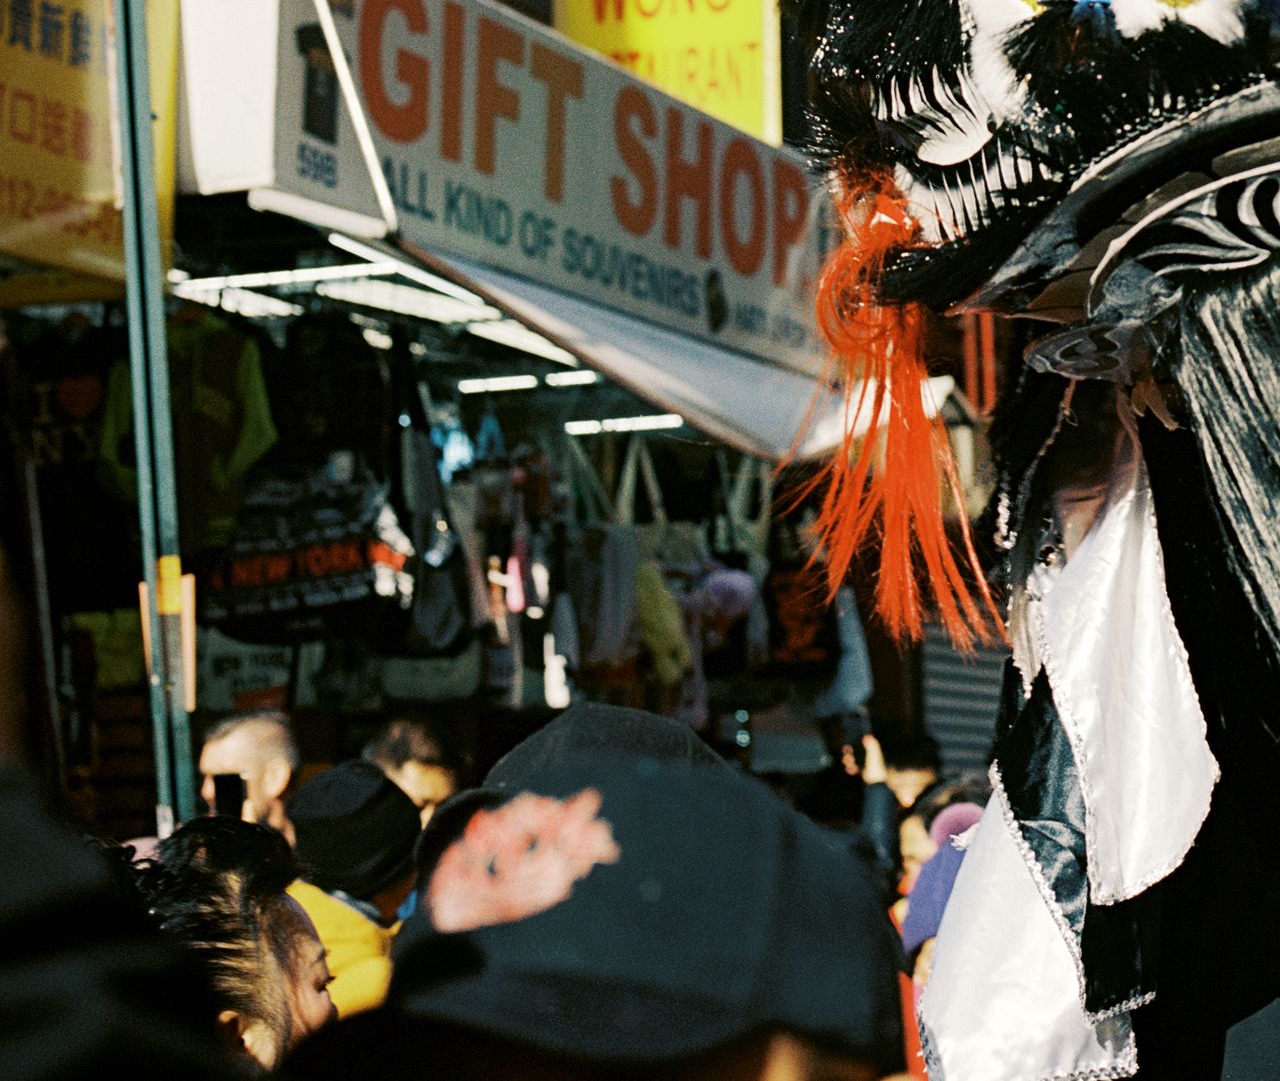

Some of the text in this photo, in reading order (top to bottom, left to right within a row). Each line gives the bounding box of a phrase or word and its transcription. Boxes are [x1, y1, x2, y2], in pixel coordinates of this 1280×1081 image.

[445, 180, 512, 247] KIND
[518, 210, 555, 261] OF
[609, 85, 809, 289] SHOP
